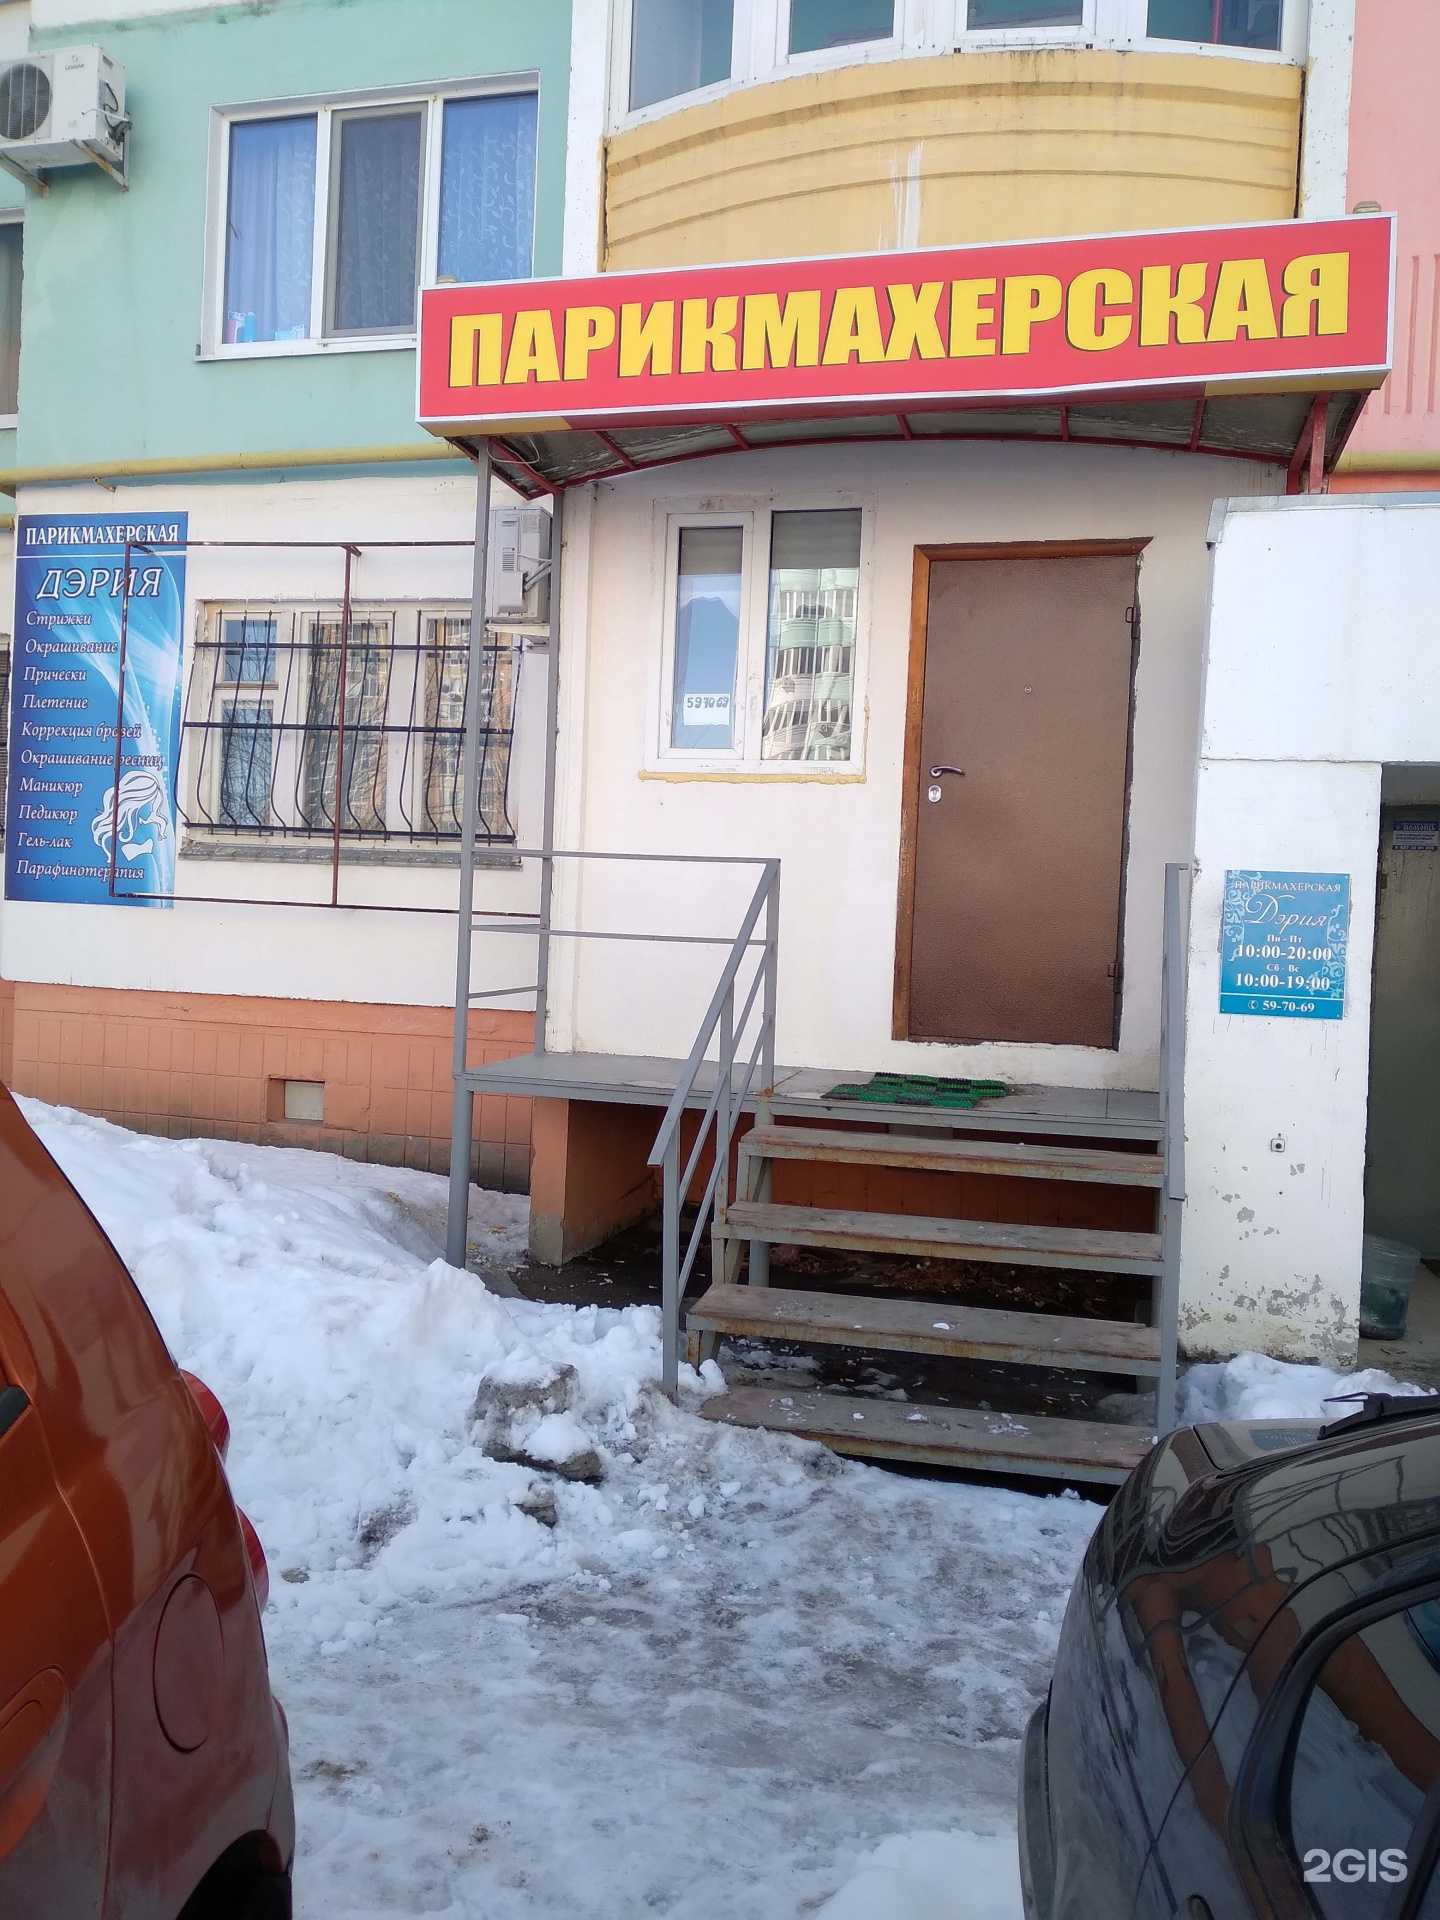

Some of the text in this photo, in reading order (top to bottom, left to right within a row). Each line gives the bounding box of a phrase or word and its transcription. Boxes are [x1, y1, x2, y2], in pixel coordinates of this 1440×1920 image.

[449, 251, 1350, 389] ПАРИКМАХЕРСКАЯ
[25, 524, 179, 546] ПАРИКМАХЕРСКАЯ
[36, 567, 163, 600] ДЭРИЯ
[26, 610, 92, 630] Стрижки
[25, 638, 118, 658] Окрашивание
[23, 666, 87, 685] Прически
[22, 694, 89, 710] Плетение
[687, 696, 702, 709] 59
[21, 721, 93, 741] Коррекция
[21, 749, 114, 768] Окрашивание
[20, 777, 84, 796] Маникюр
[18, 804, 79, 825] Педикюр
[17, 832, 72, 849] Гель-лак
[1234, 880, 1342, 893] ПАРИКМАХЕРСКАЯ
[1244, 893, 1329, 934] Дэрия
[1237, 943, 1332, 961] 10:00-20:00
[1235, 973, 1331, 991] 10:00-19:00
[1262, 1000, 1316, 1013] 59-70-69
